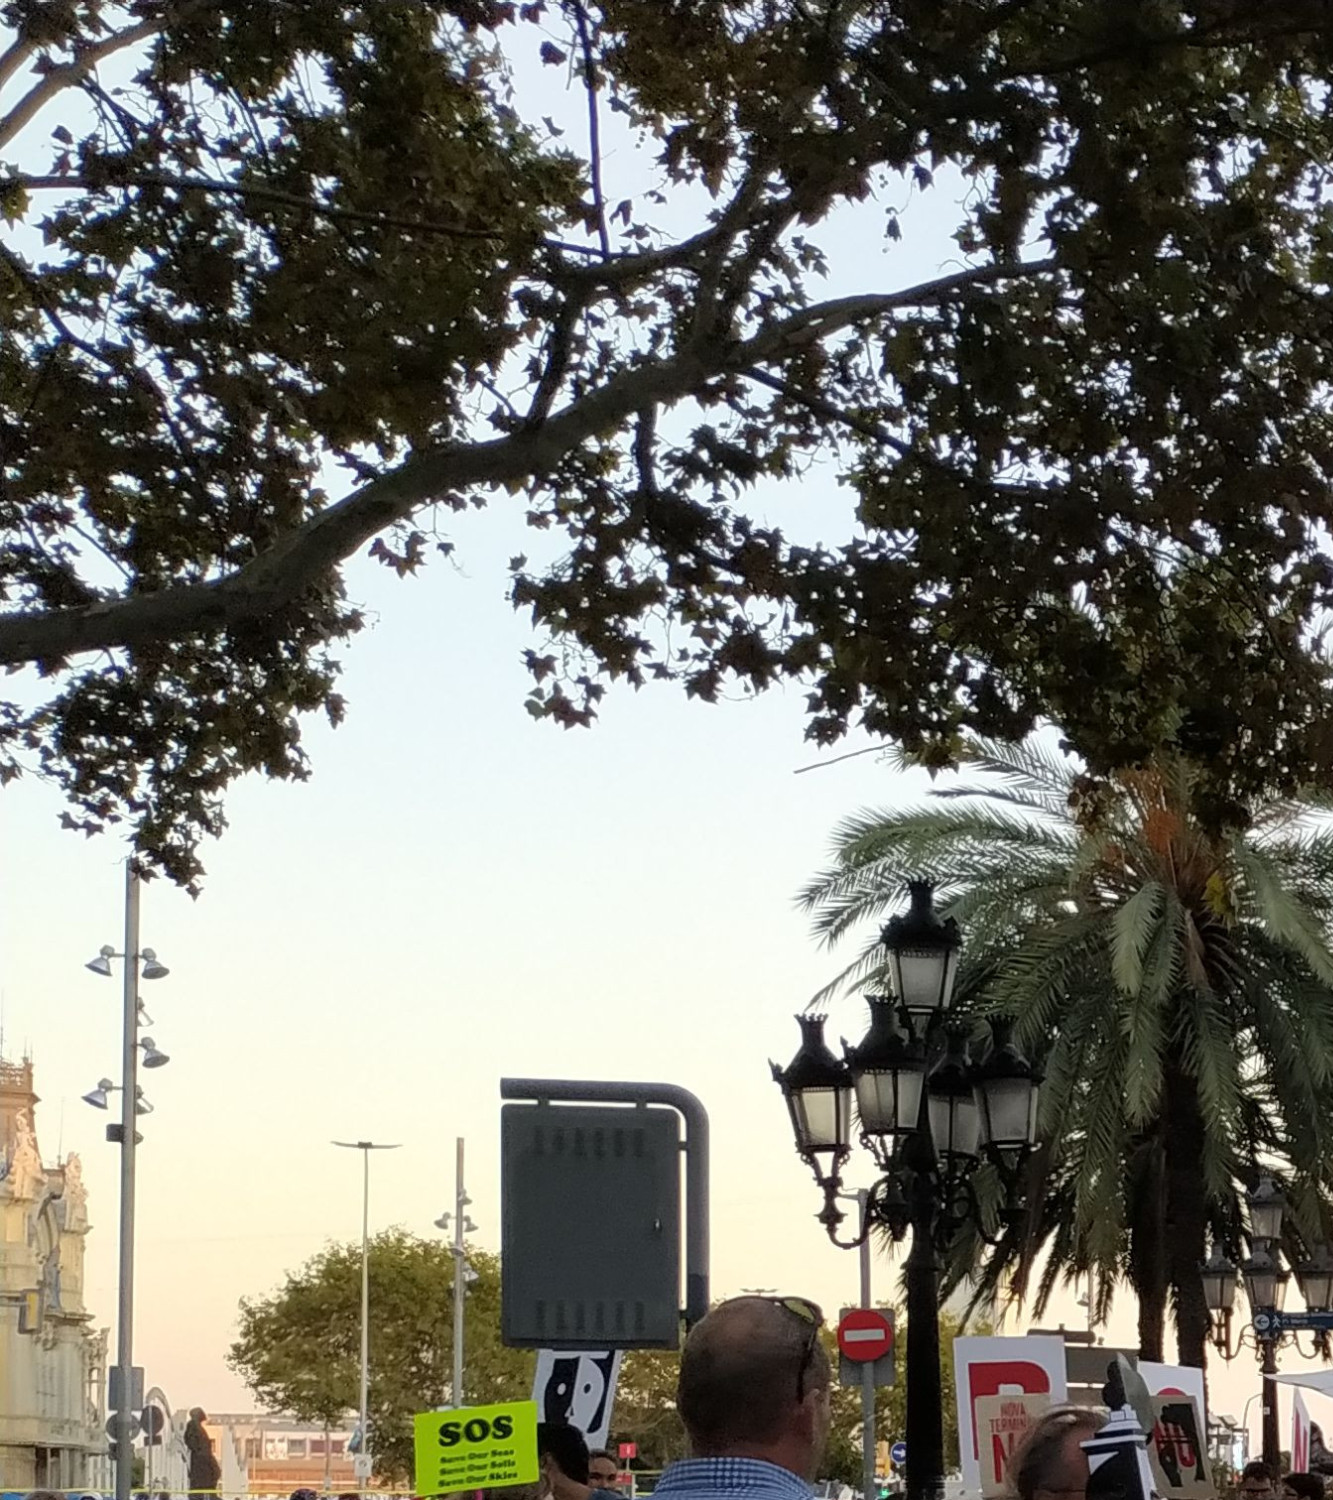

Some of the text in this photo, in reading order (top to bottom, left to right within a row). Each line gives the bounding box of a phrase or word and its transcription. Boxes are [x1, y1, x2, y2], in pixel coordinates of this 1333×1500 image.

[1001, 1401, 1026, 1416] NOVA
[438, 1415, 513, 1447] SOS
[989, 1415, 1028, 1433] TERMIN
